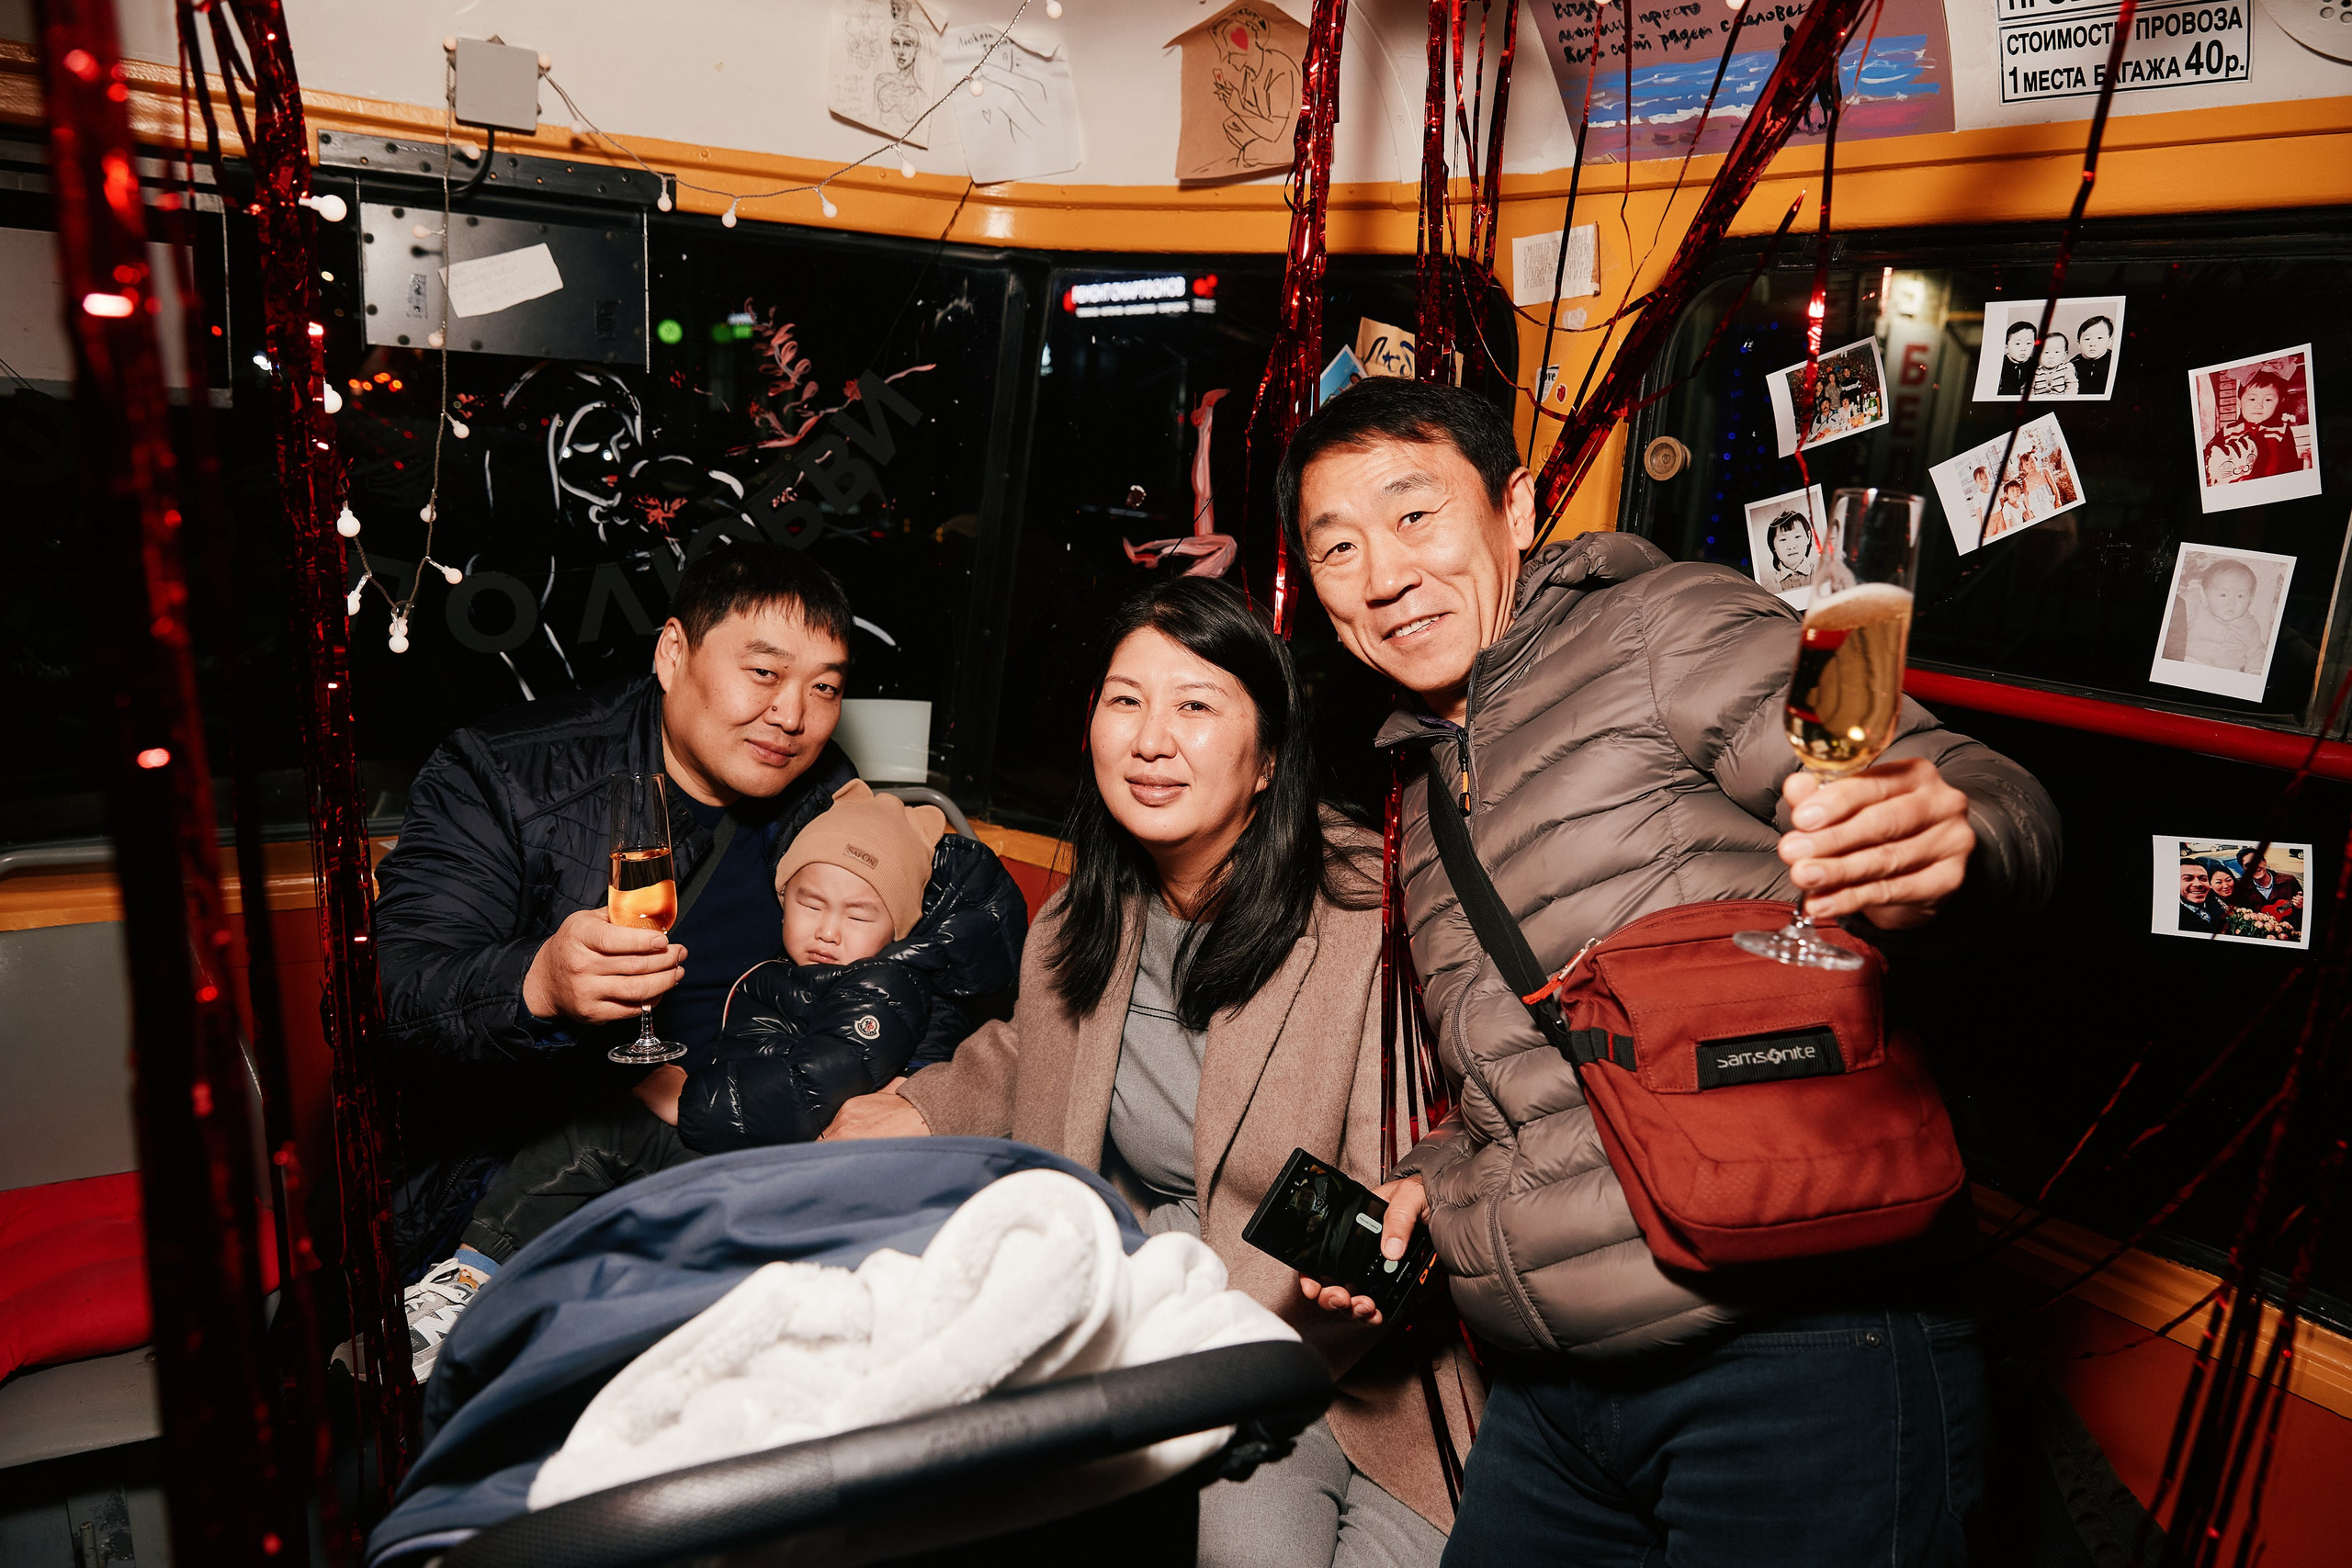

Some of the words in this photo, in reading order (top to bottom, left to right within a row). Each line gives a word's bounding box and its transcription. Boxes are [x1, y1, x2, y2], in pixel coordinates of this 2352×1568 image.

[2135, 6, 2243, 40] ПРОВОЗА
[2023, 67, 2086, 93] МЕСТА
[1715, 1045, 1816, 1069] samsonite
